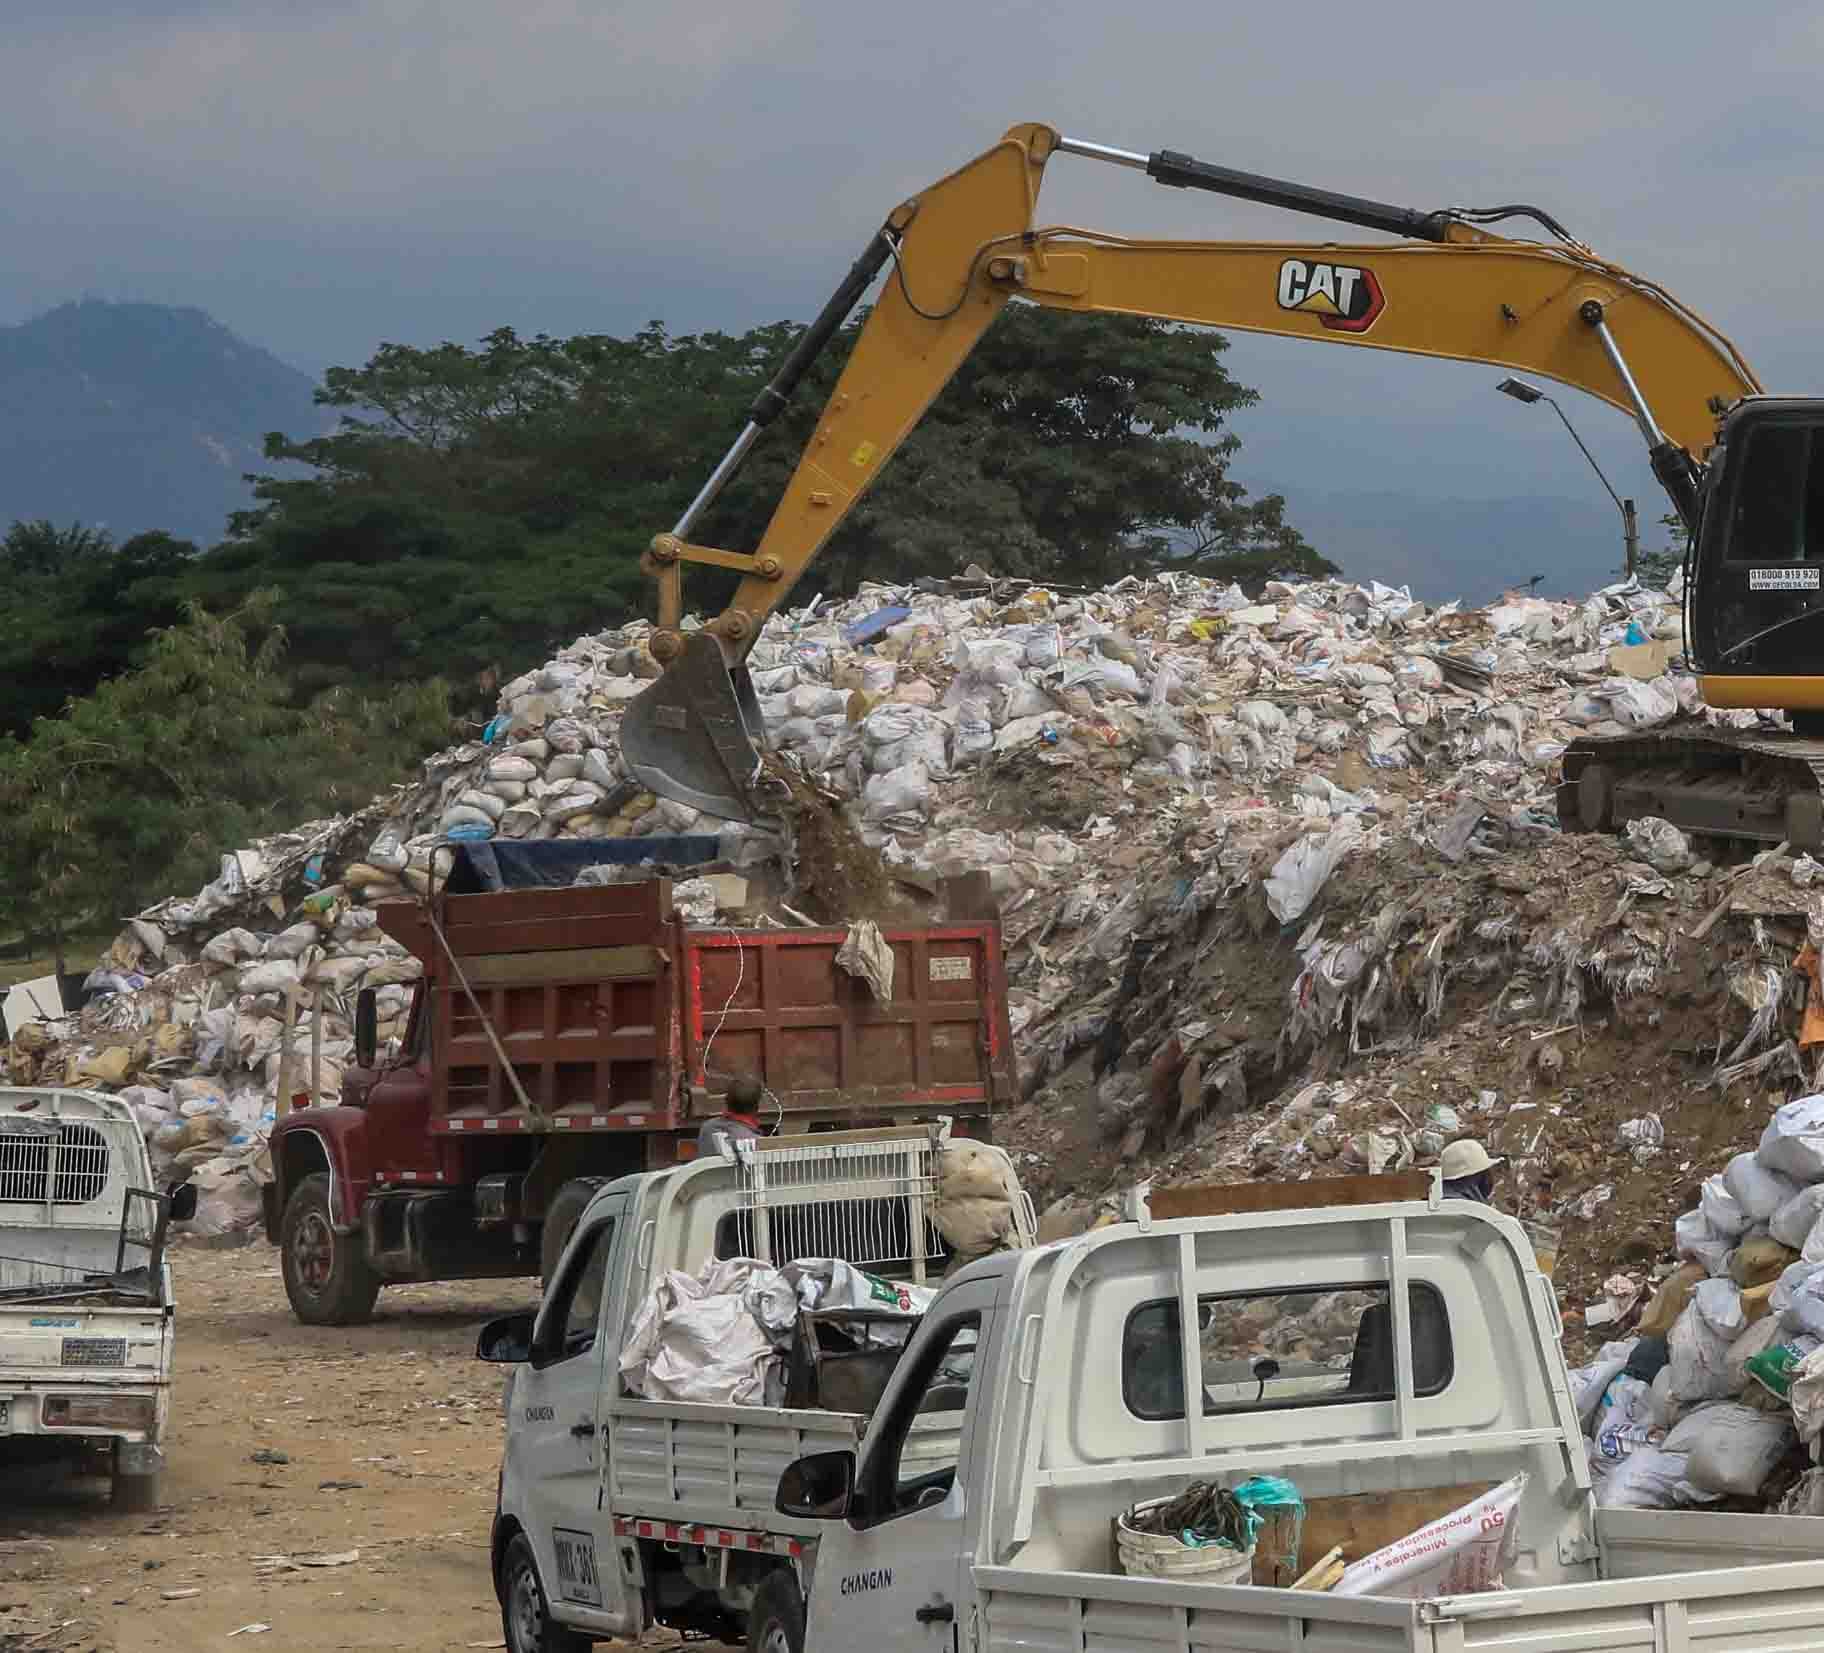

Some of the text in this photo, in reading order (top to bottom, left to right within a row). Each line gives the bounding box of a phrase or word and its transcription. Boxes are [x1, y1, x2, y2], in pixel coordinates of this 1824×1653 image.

[1278, 258, 1361, 316] CAT
[1785, 570, 1801, 580] 919
[1803, 569, 1819, 579] 920
[1480, 1511, 1505, 1534] 50
[840, 1567, 893, 1596] CHANGAN
